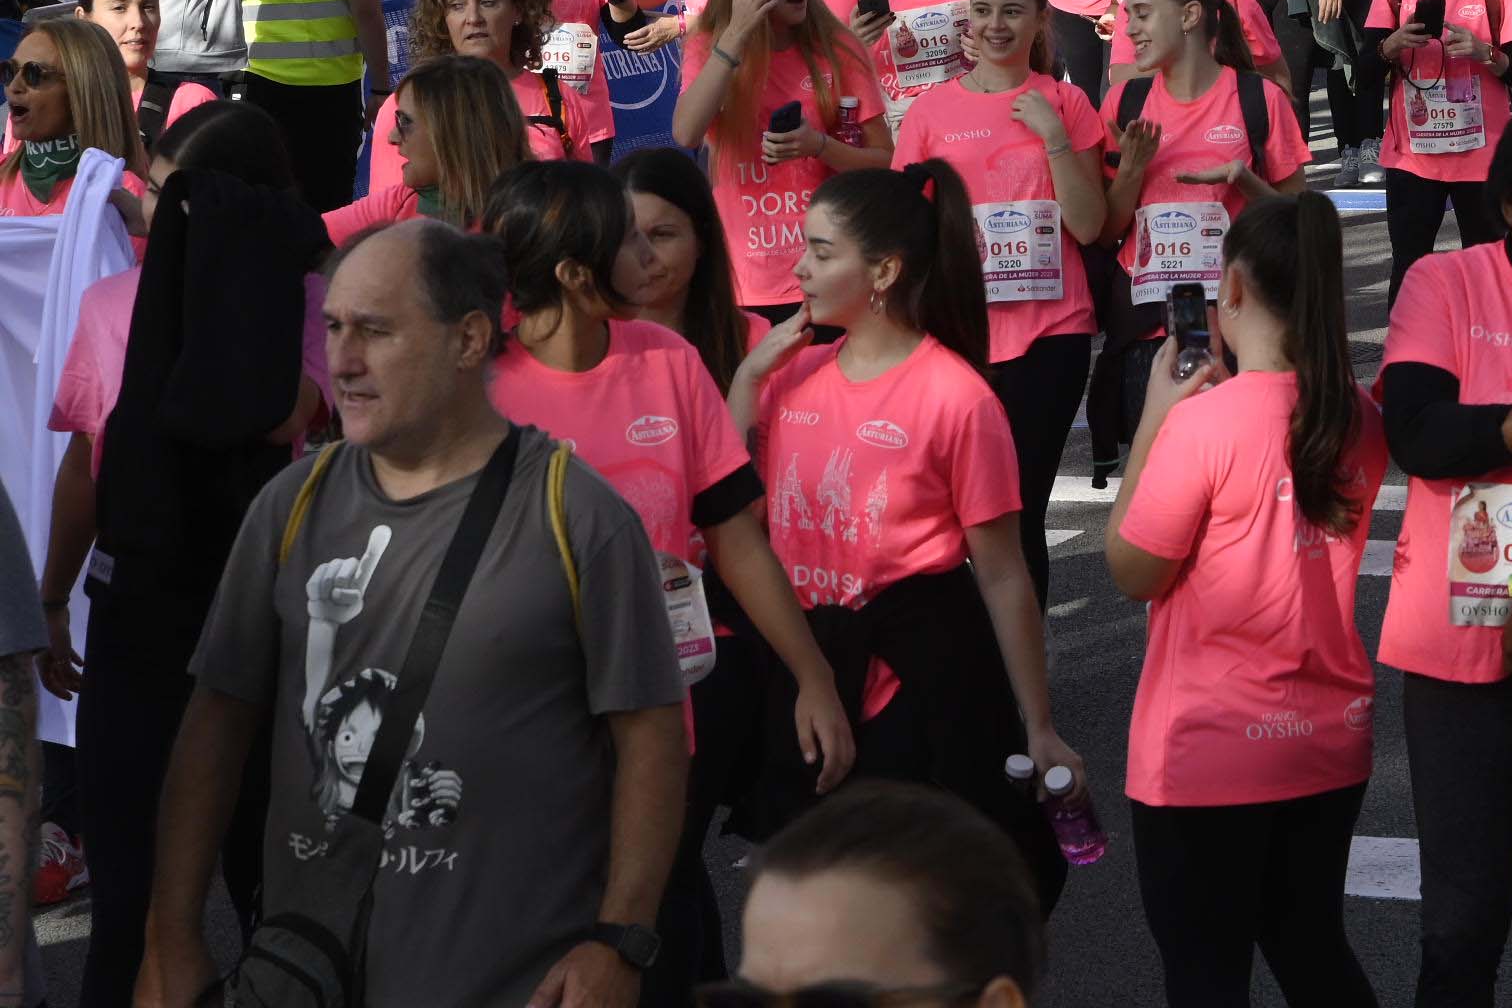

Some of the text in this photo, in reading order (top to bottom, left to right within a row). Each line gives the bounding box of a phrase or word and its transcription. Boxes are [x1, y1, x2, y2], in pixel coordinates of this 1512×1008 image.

[914, 18, 947, 29] ASTURIANA
[920, 34, 949, 49] 016
[543, 51, 570, 62] 016
[925, 49, 948, 58] 32096
[905, 71, 931, 82] OYSHO
[1430, 108, 1457, 120] 016
[1432, 122, 1455, 130] 27579
[945, 128, 991, 143] OYSHO
[987, 219, 1029, 229] ASTURIANA
[1153, 220, 1194, 229] ASTURIANA
[990, 240, 1029, 256] 016
[1154, 242, 1192, 256] 016
[998, 259, 1022, 269] 5220
[1160, 260, 1183, 270] 5221
[1180, 271, 1202, 279] MUJER
[631, 426, 675, 441] ASTURIANA
[860, 426, 904, 444] ASTURIANA
[1461, 604, 1510, 618] OYSHO
[1245, 719, 1313, 742] OYSHO
